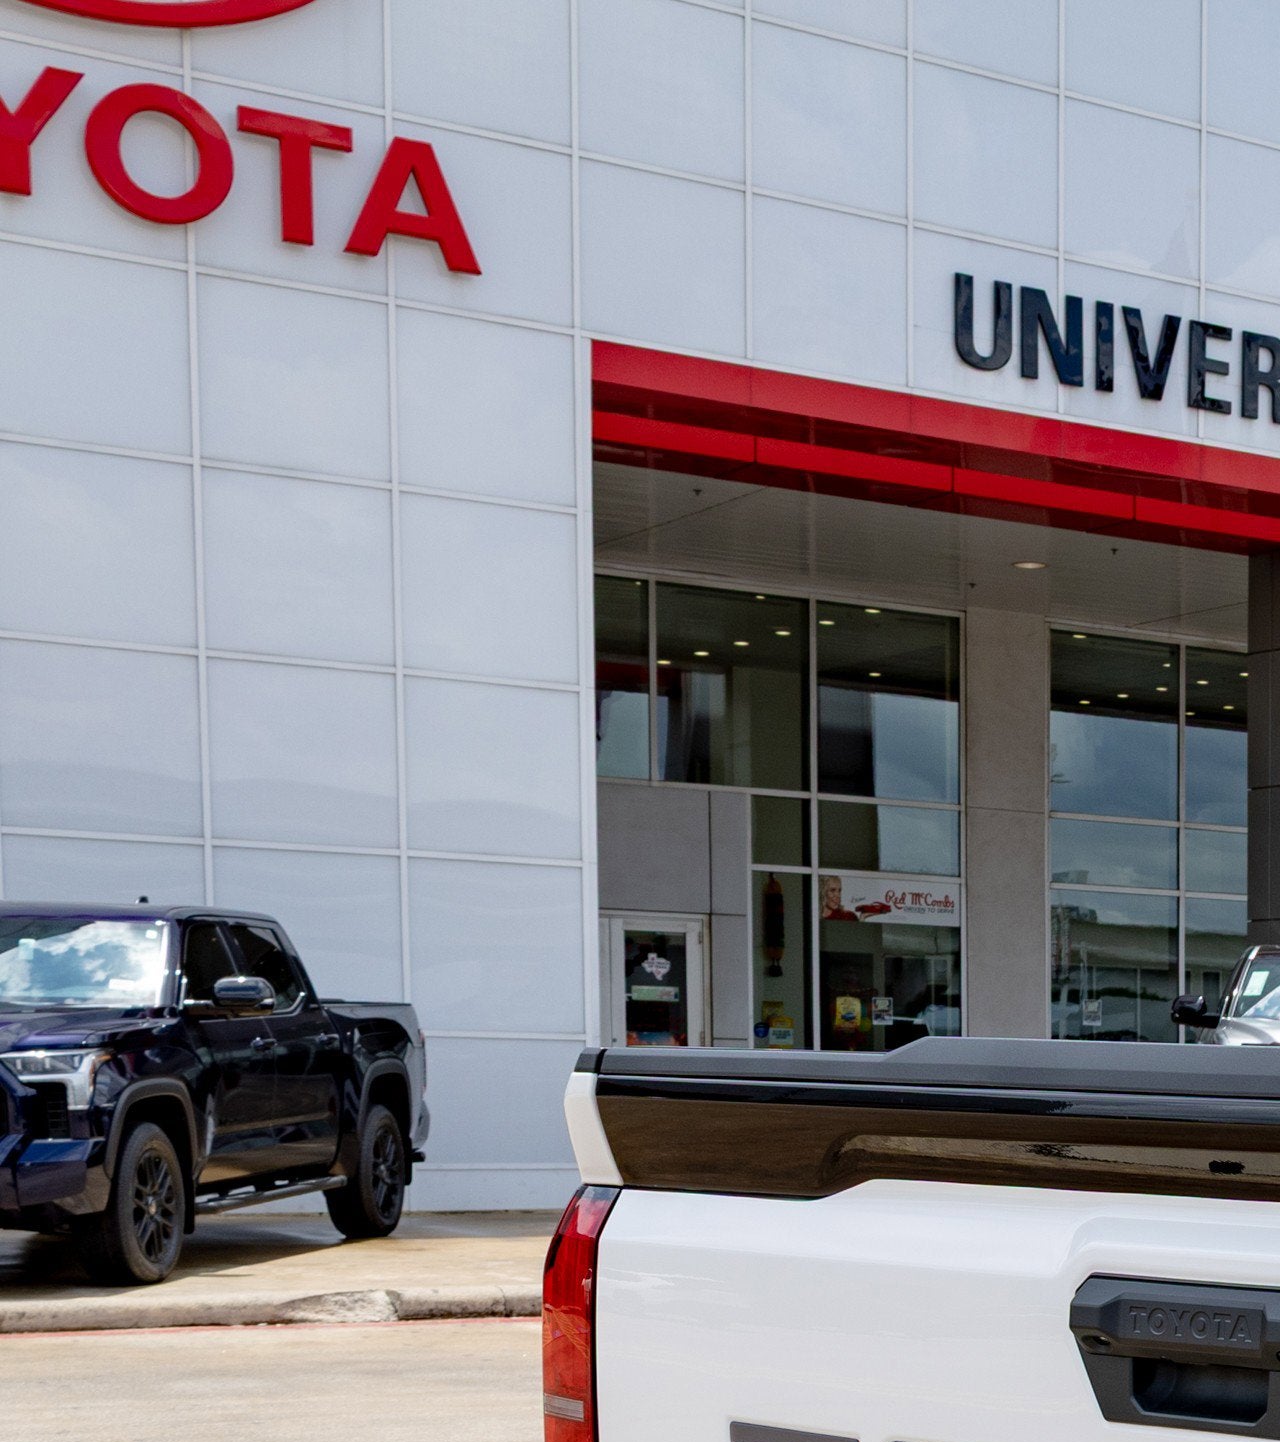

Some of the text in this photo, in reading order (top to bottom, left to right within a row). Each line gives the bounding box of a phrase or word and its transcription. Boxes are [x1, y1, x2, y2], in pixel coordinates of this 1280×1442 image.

[885, 889, 955, 910] Red McCombs
[1129, 1305, 1252, 1342] TOYOTA
